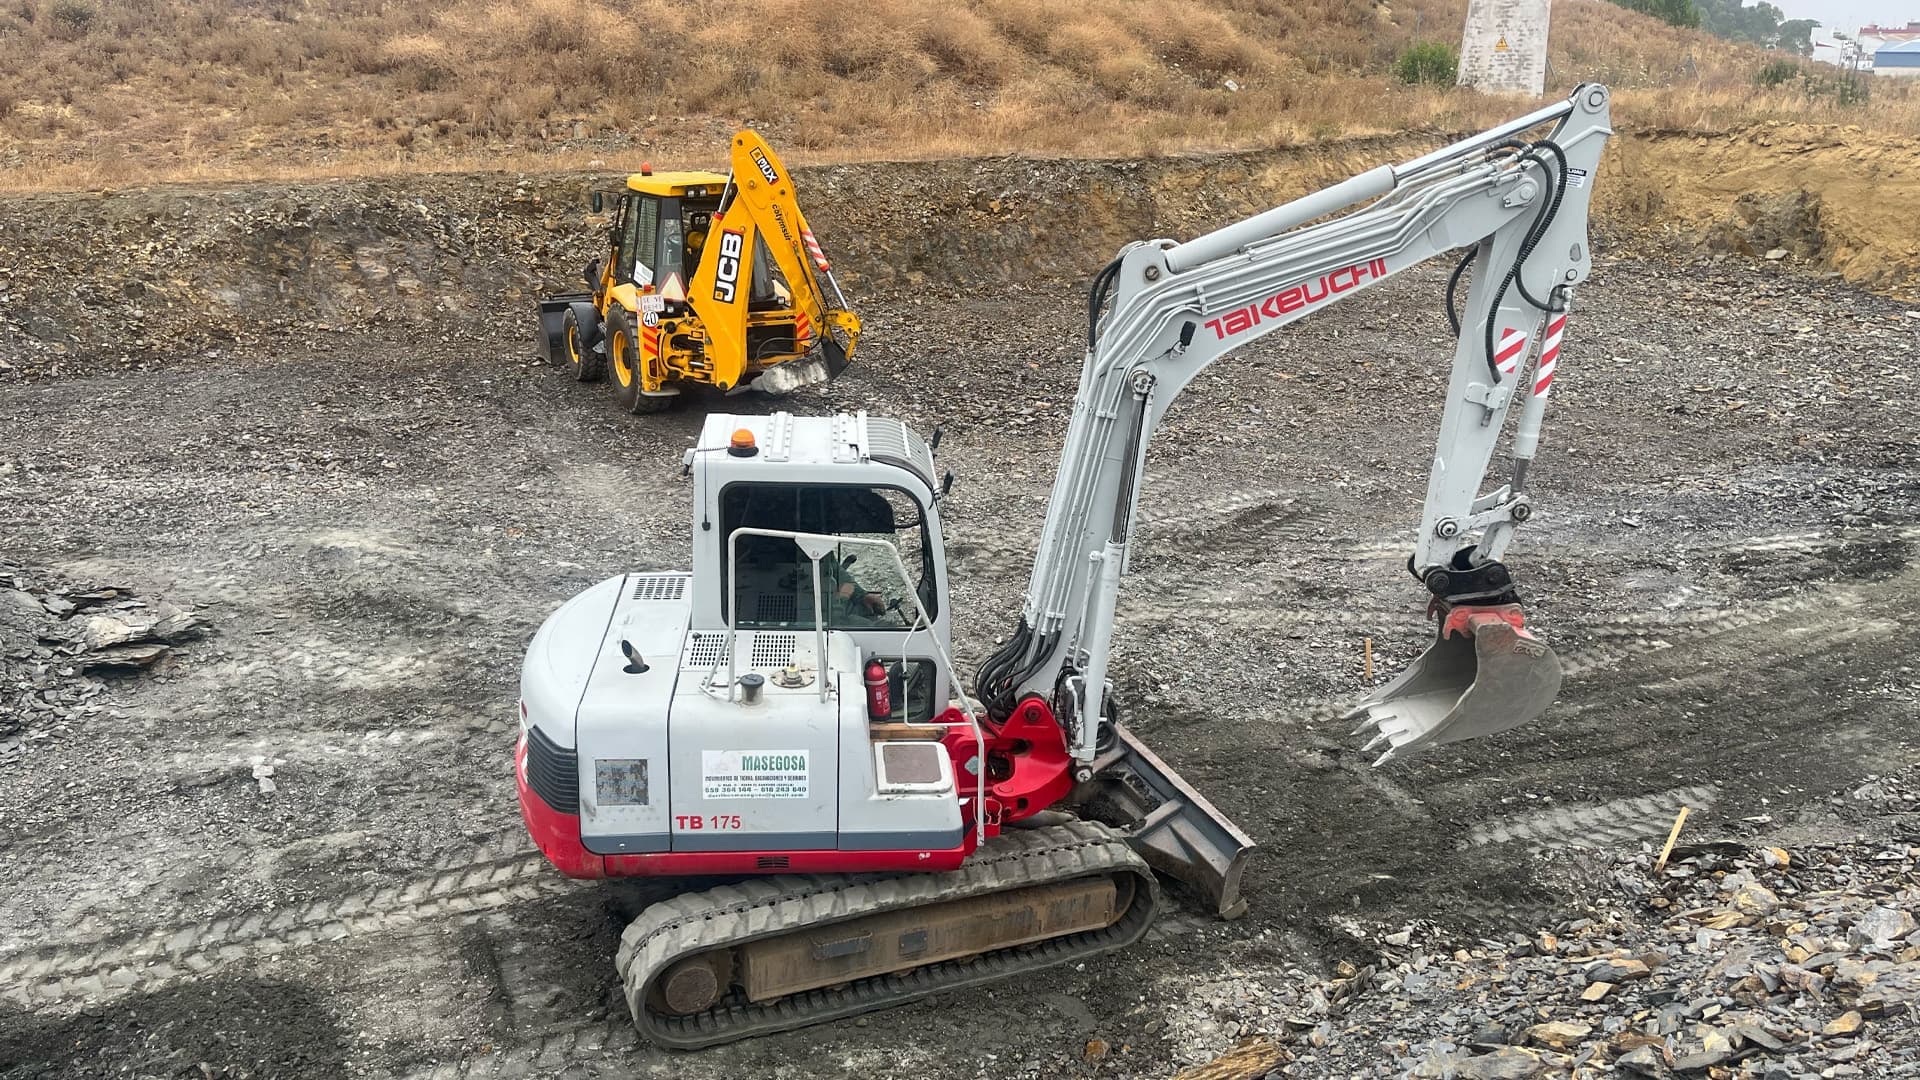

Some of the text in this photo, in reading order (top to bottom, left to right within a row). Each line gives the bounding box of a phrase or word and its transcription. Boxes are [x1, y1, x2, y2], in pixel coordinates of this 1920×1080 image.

[716, 233, 742, 302] JCB
[644, 311, 657, 325] 40
[742, 755, 806, 771] MASEGOSA
[675, 815, 741, 830] TB 175
